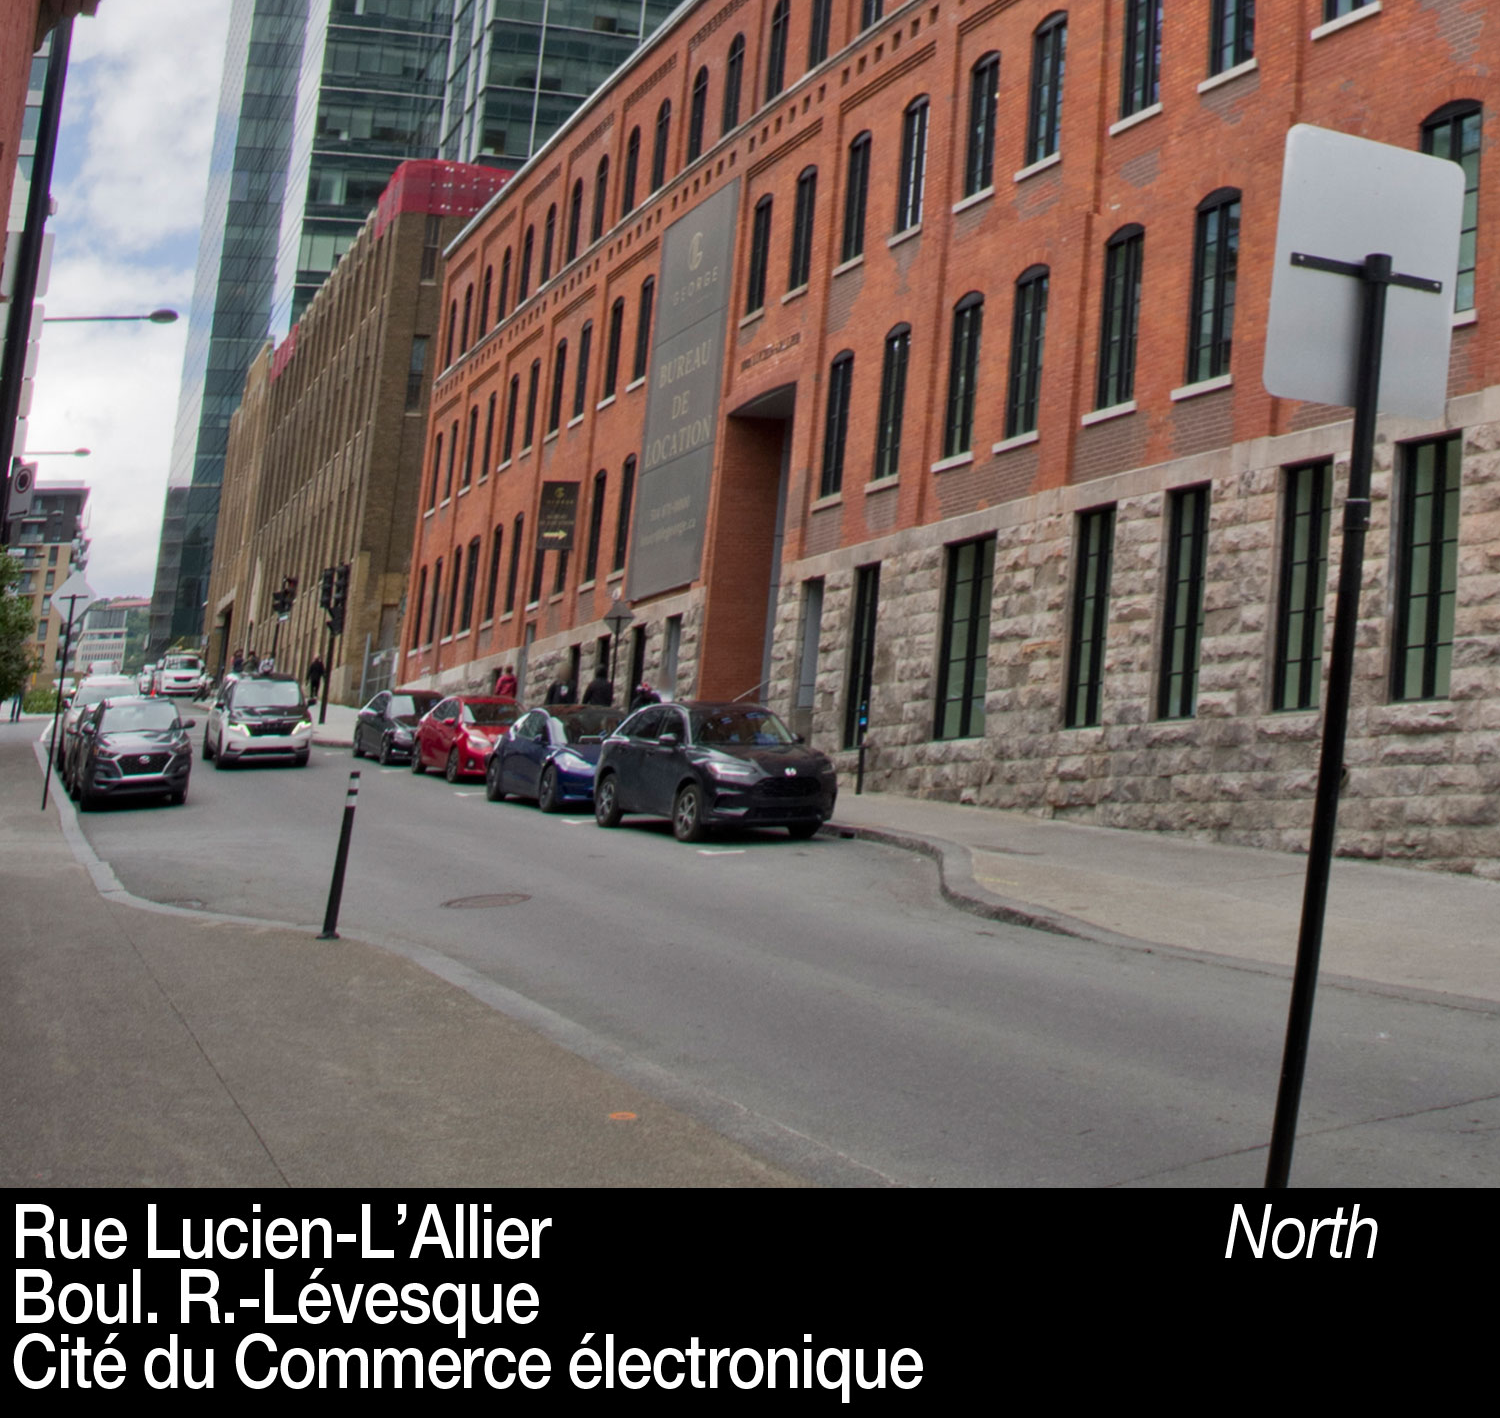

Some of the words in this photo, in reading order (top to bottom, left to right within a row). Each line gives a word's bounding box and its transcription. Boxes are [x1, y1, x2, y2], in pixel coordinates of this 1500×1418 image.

[659, 339, 713, 389] BUREAU
[671, 390, 690, 420] DE
[644, 415, 713, 469] LOCATION
